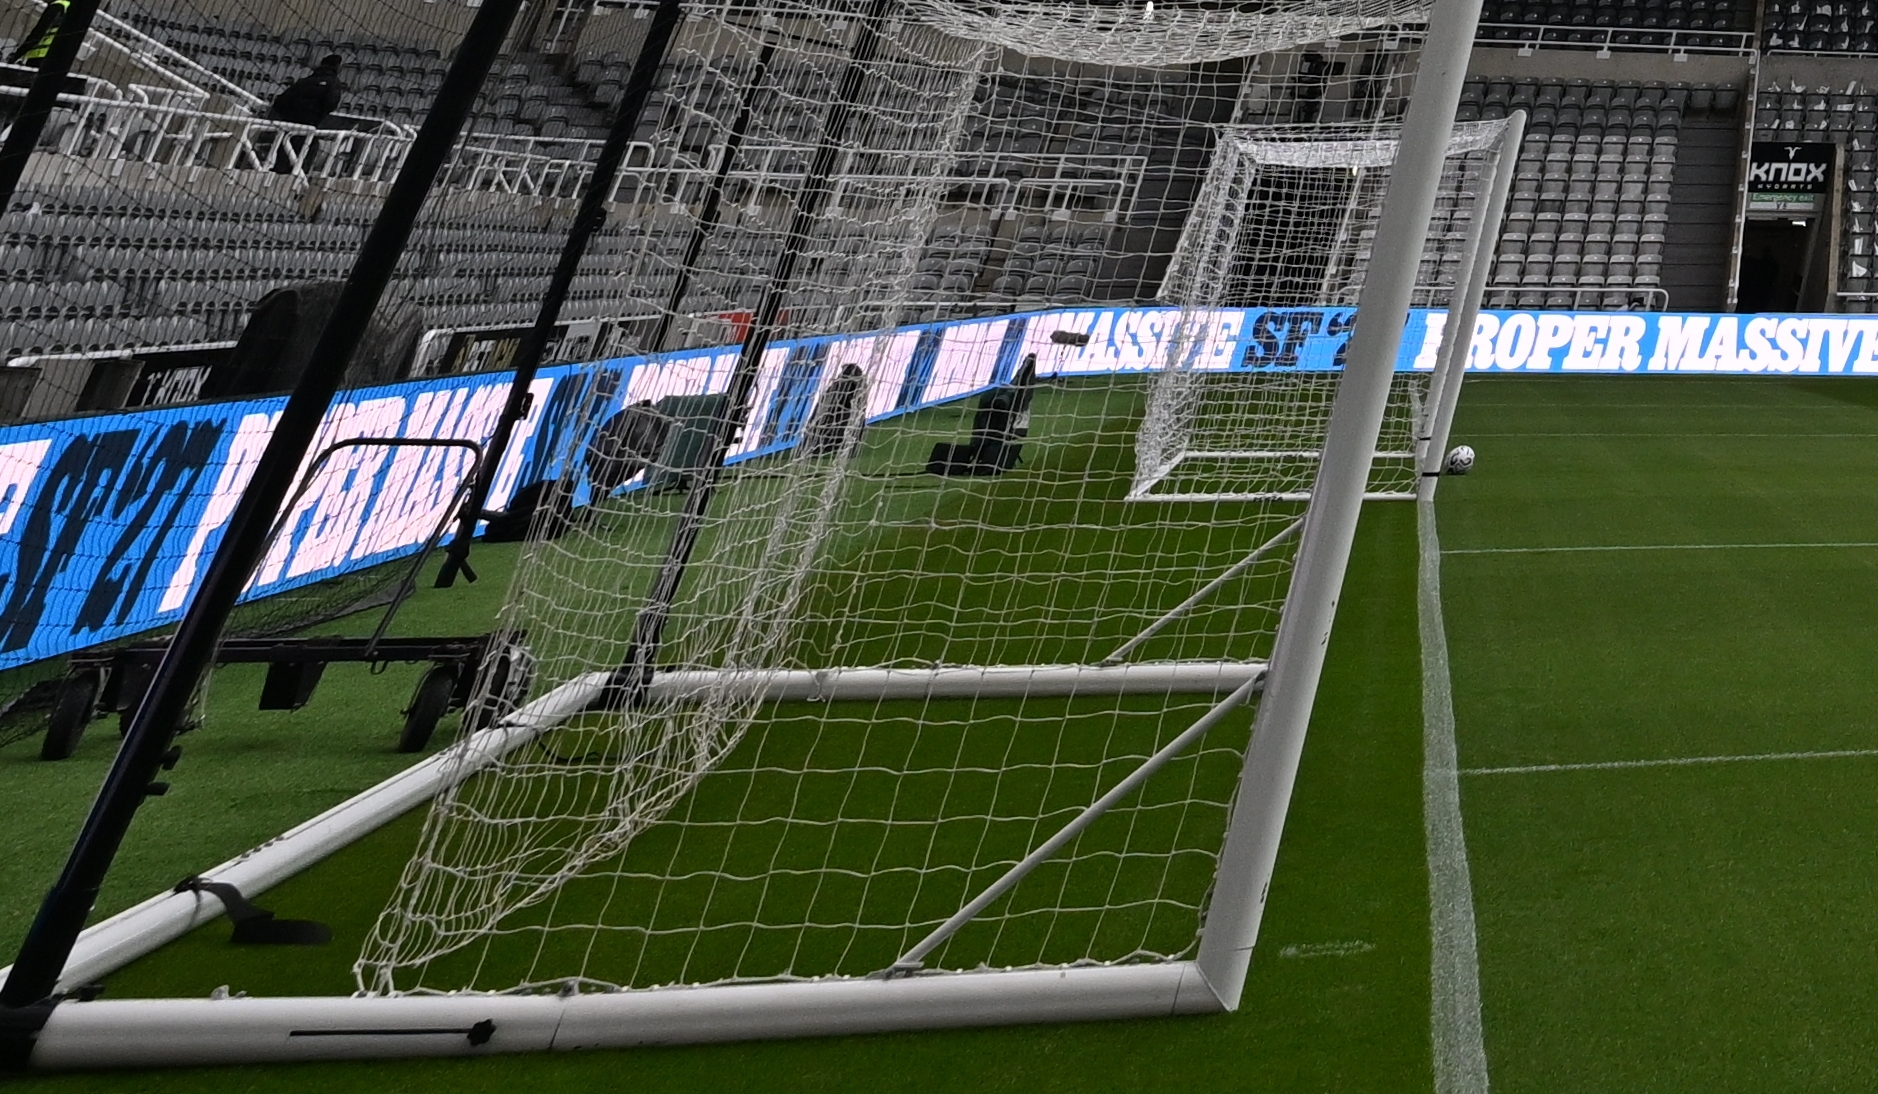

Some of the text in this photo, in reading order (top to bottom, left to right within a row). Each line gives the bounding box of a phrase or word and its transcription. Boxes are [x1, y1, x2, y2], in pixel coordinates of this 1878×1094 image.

[1750, 162, 1827, 182] KNOX
[1752, 193, 1797, 202] Emergency
[1241, 311, 1325, 367] SF
